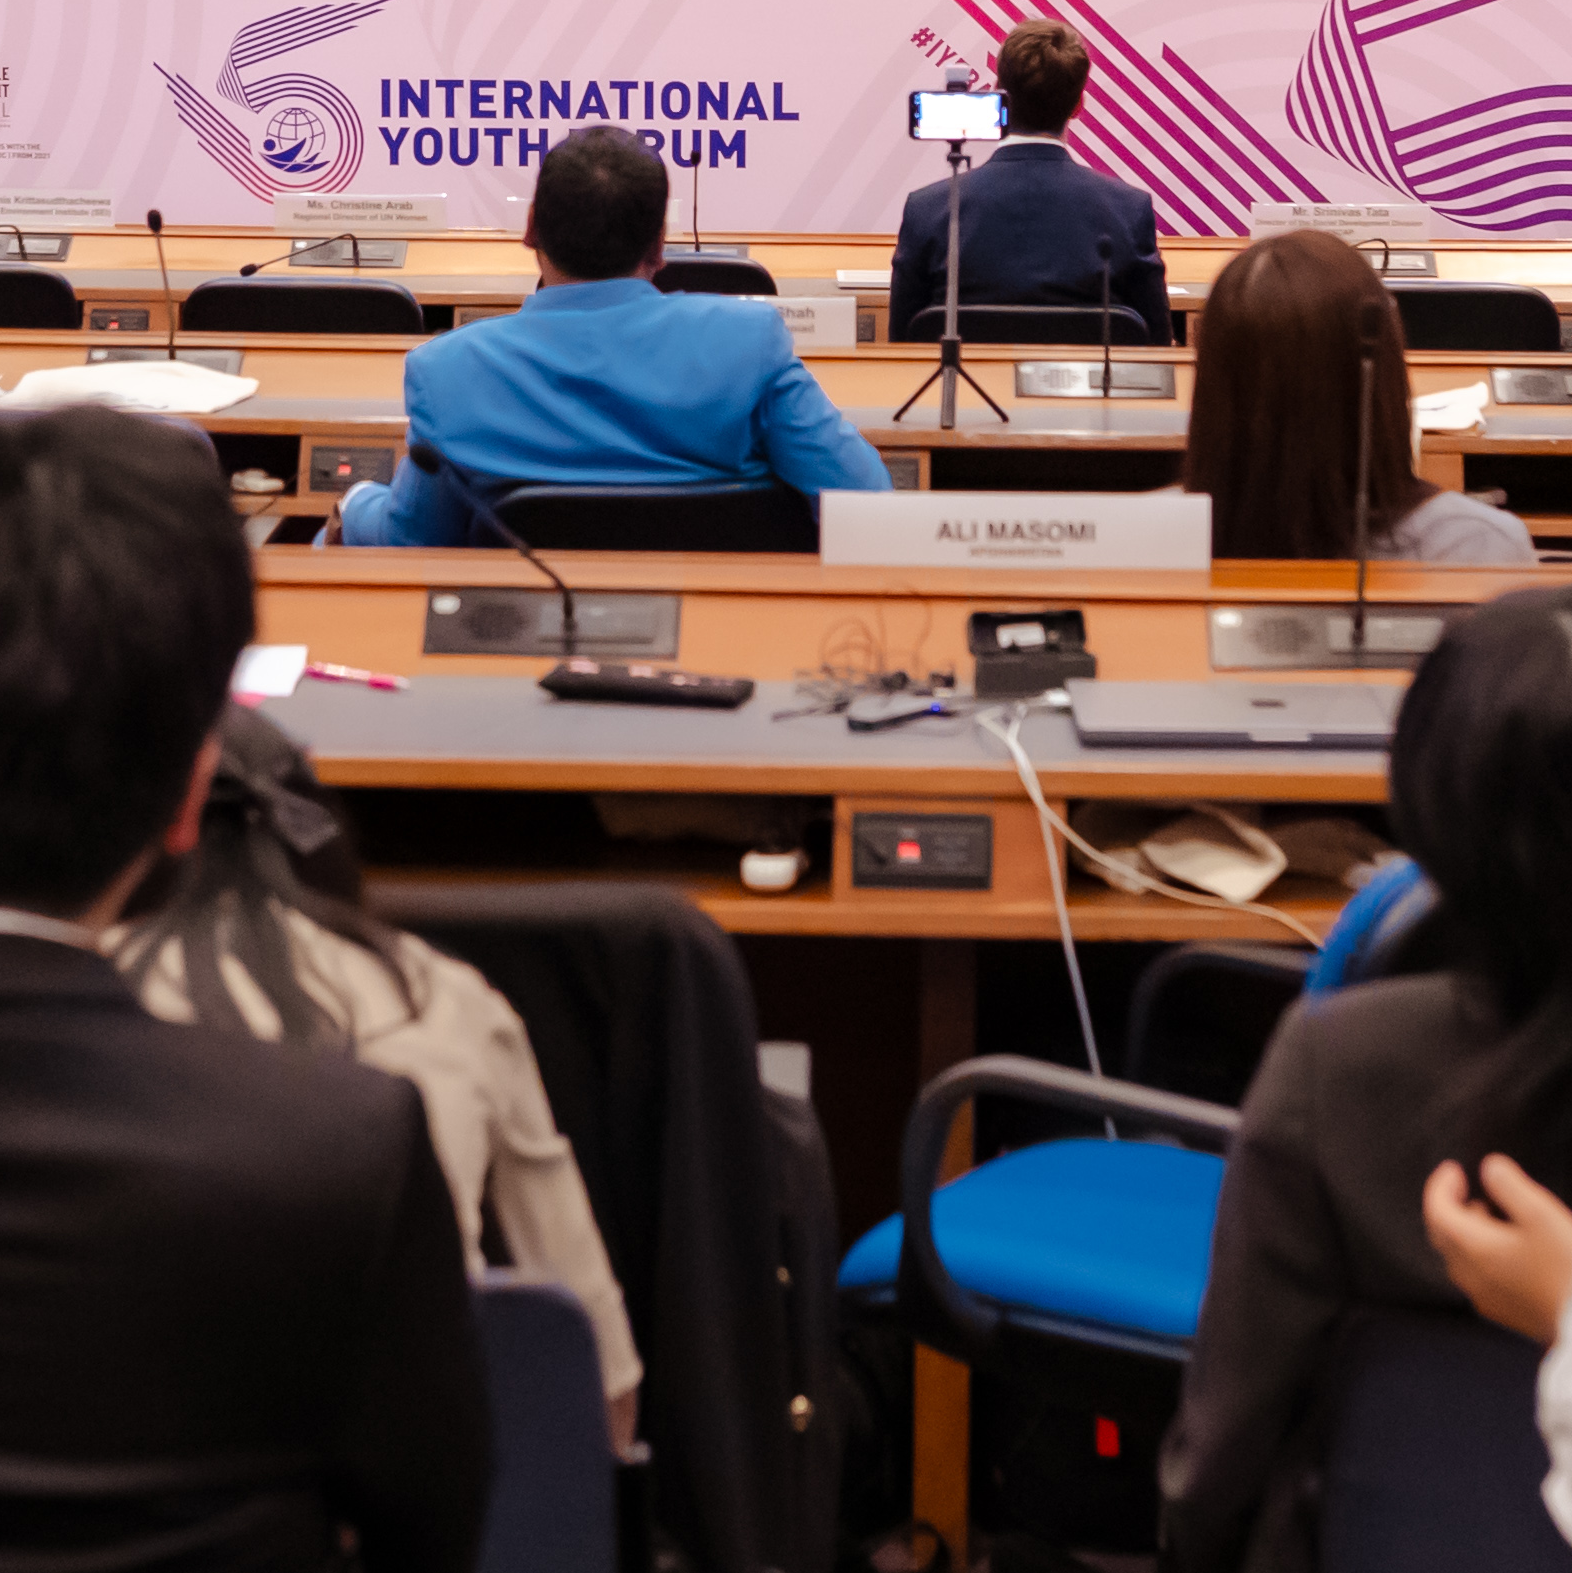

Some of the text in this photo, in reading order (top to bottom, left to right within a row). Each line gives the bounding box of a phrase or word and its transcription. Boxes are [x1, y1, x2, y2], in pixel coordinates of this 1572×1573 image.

[380, 79, 800, 121] INTERNATIONAL
[378, 127, 549, 166] YOUTH
[330, 200, 382, 210] Christine
[937, 521, 1096, 542] ALI MASOMI
